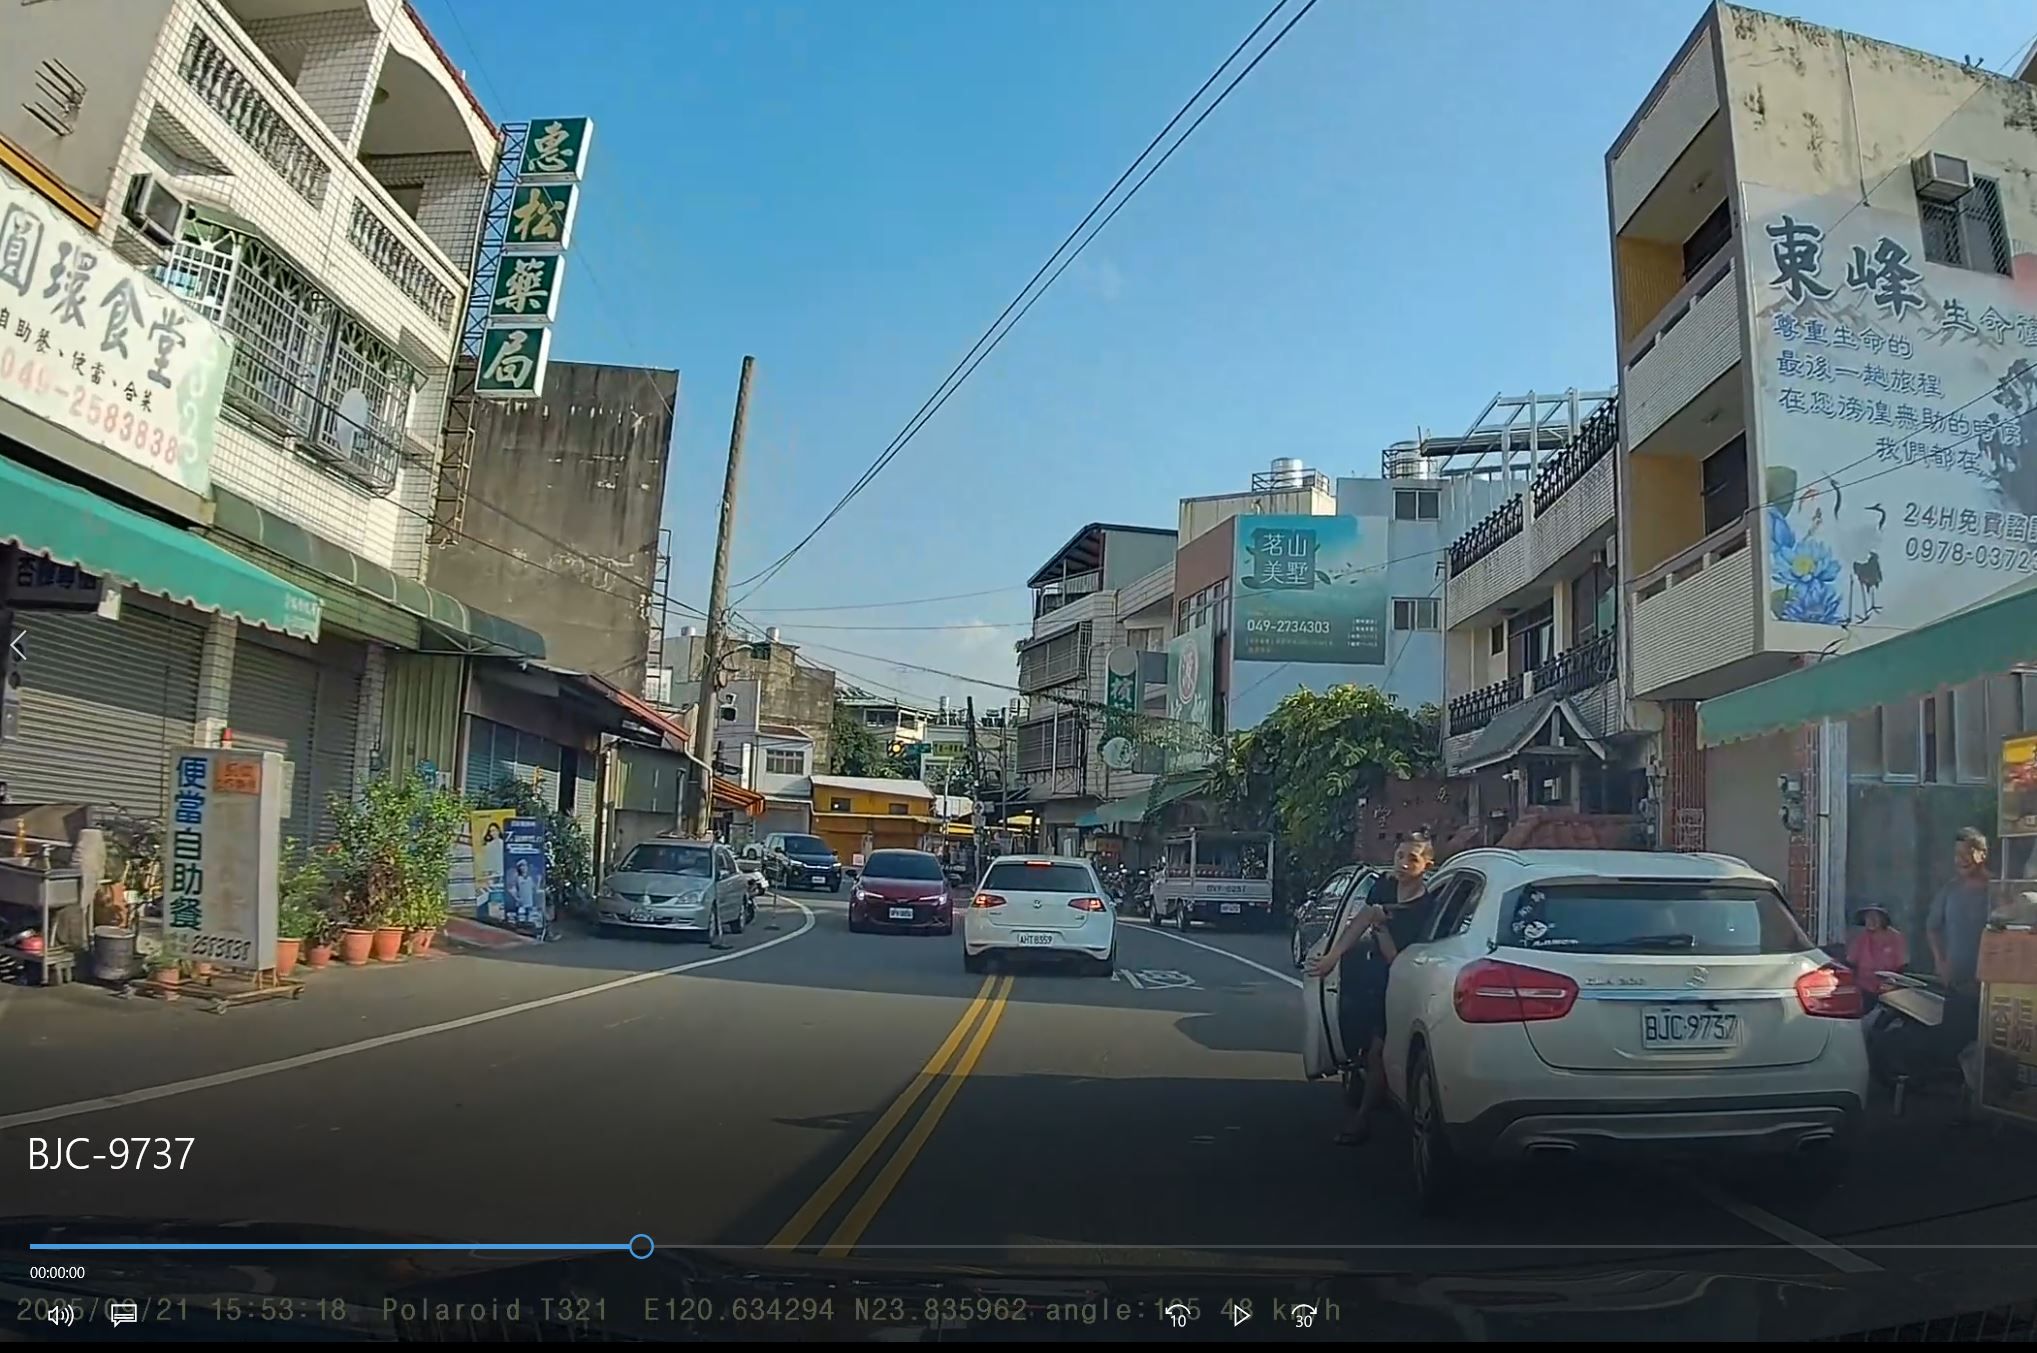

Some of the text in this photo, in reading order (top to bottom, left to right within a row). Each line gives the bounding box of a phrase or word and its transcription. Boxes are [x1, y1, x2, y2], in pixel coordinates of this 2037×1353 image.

[483, 120, 575, 389] 惠松藥局
[1766, 214, 1929, 323] 東峰
[1904, 502, 2037, 544] 24H免費諮
[1247, 619, 1330, 633] 049-2734303
[168, 756, 208, 931] 便當自助餐
